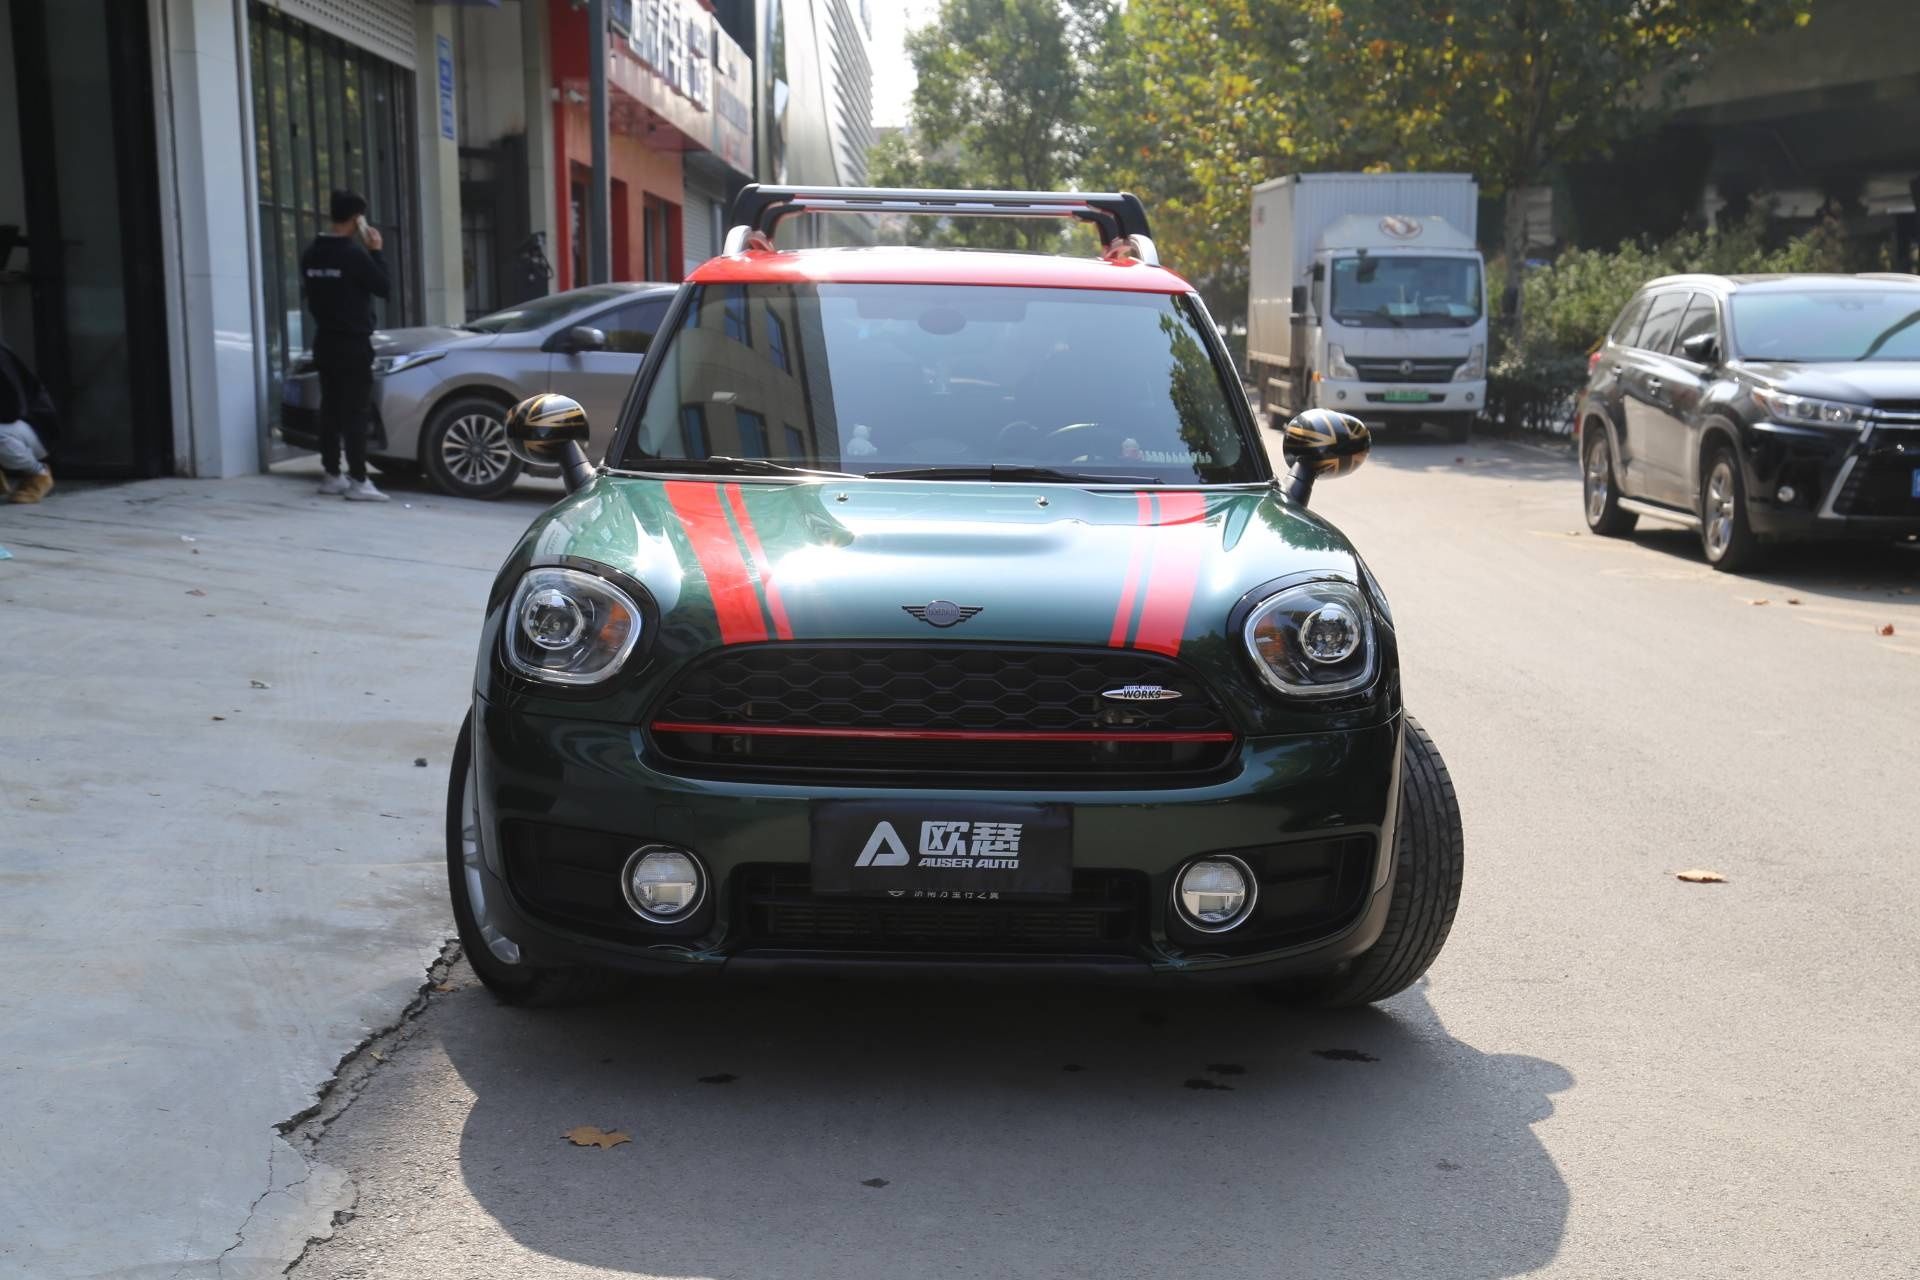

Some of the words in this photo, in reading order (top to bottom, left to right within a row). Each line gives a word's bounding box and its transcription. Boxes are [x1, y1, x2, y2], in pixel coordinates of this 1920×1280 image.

[1123, 690, 1162, 699] WORKS
[919, 858, 973, 868] AUSER
[976, 859, 1019, 869] AUTO
